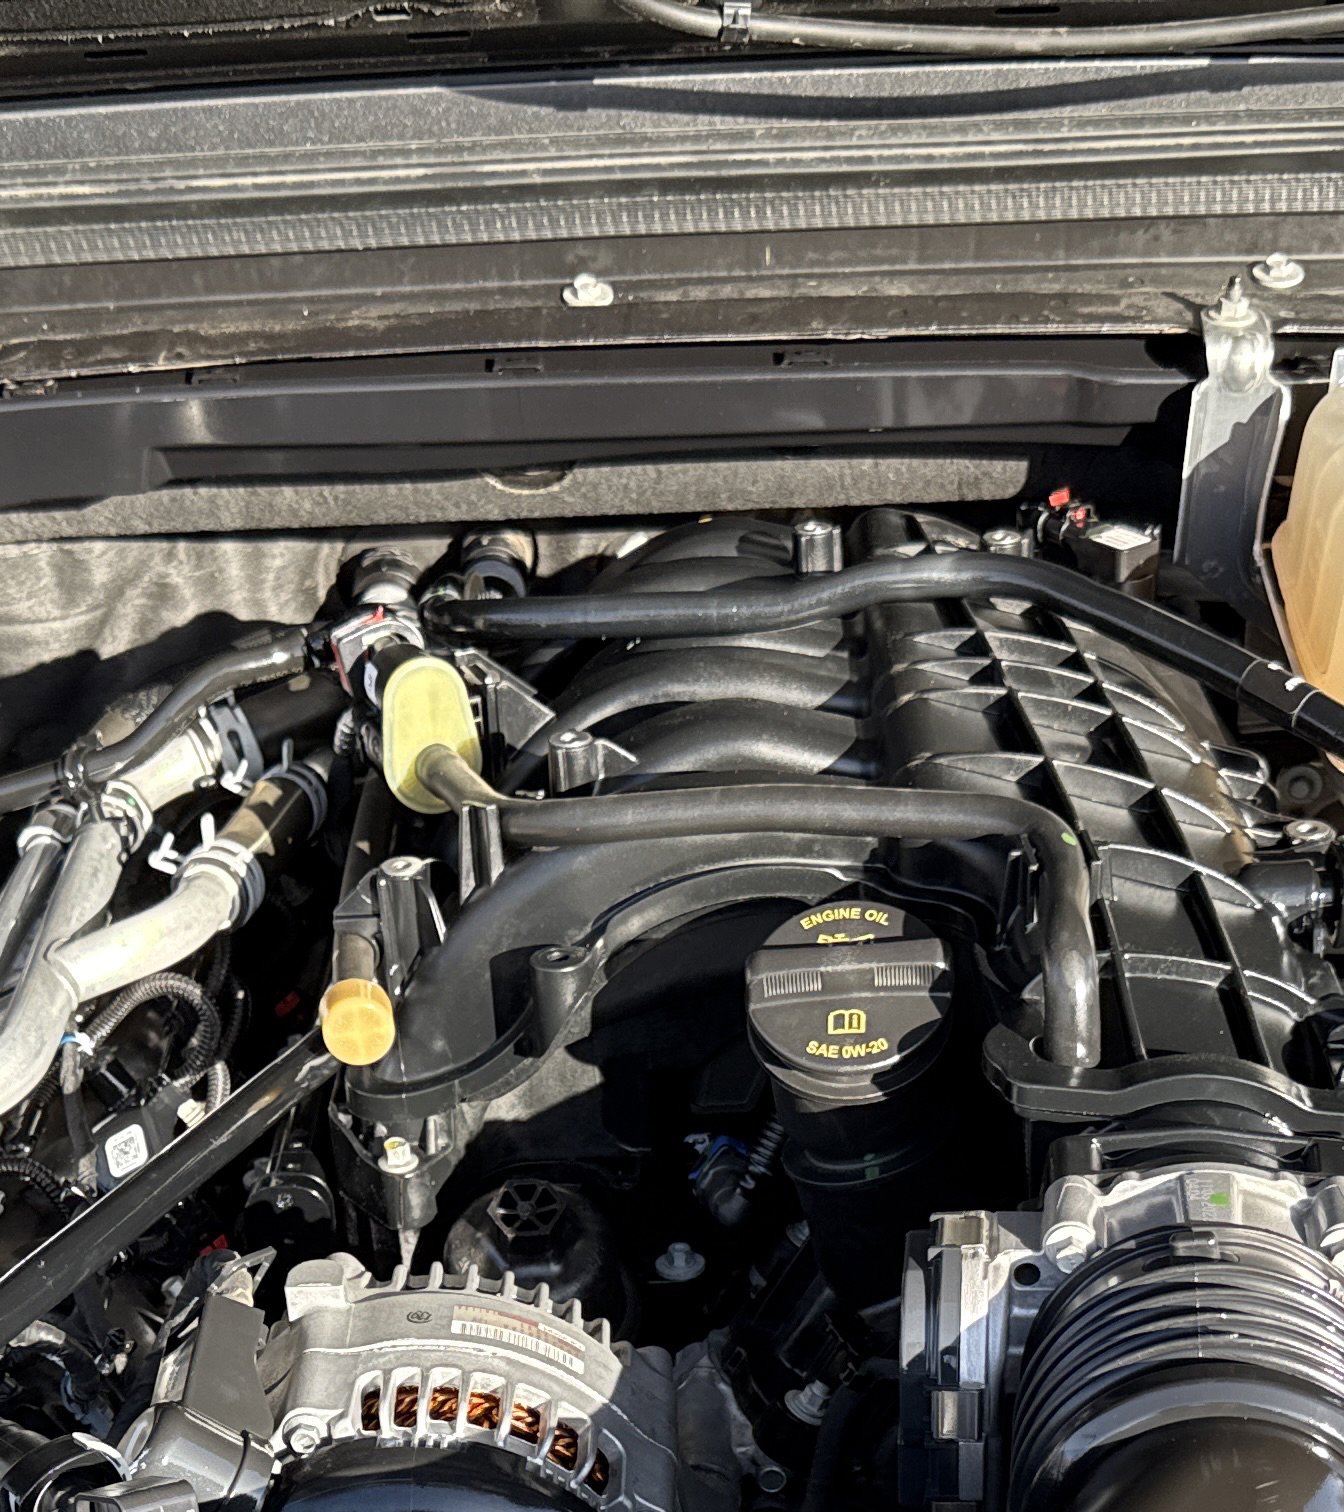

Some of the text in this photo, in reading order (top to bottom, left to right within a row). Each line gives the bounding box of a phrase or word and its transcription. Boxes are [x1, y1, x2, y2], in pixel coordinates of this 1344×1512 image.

[800, 908, 889, 930] ENGINE OIL
[806, 1037, 888, 1058] SAE 0W-20
